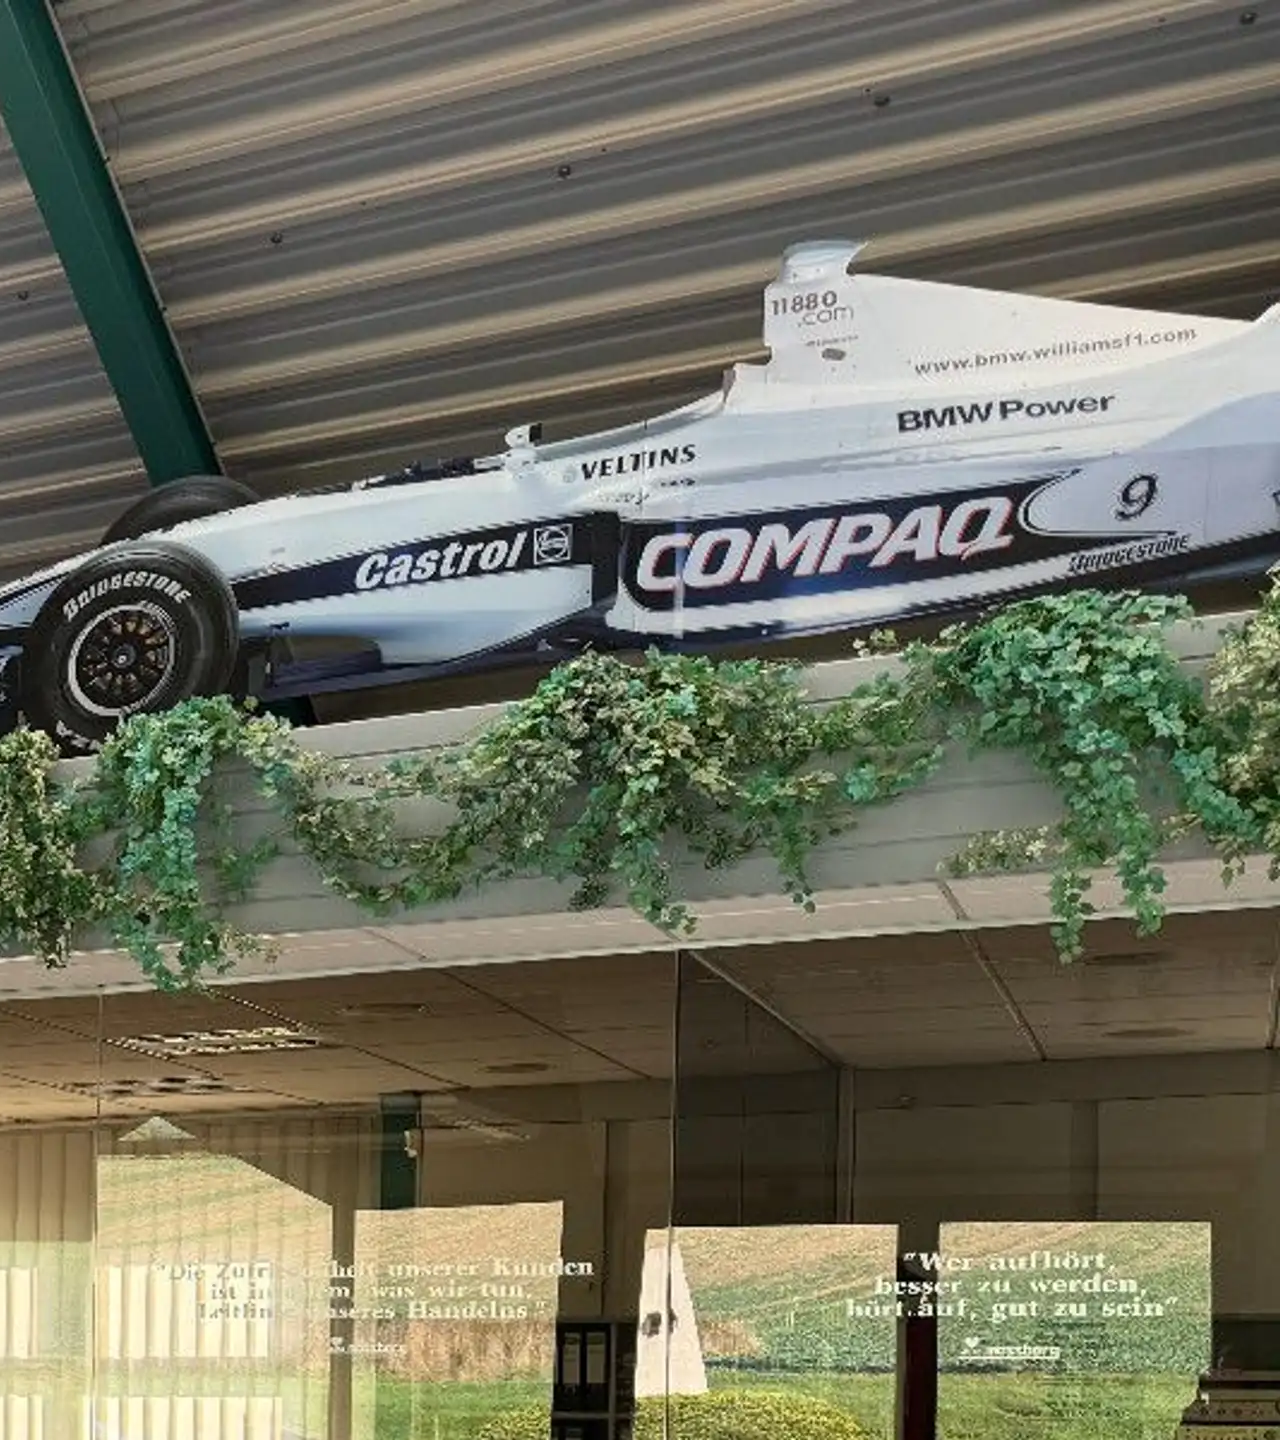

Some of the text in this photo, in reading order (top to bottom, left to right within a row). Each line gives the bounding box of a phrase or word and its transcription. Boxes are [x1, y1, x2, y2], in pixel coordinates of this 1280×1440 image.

[772, 290, 837, 316] 11880
[897, 393, 1116, 433] BMW Power
[582, 444, 696, 481] VELTINS
[1114, 474, 1158, 522] 9
[355, 531, 528, 590] Castrol
[637, 495, 1015, 592] COMPAQ
[495, 1257, 595, 1276] Kunden
[977, 1280, 1011, 1293] zu
[1030, 1272, 1147, 1298] werden,
[989, 1300, 1039, 1323] gut
[1053, 1302, 1087, 1317] zu
